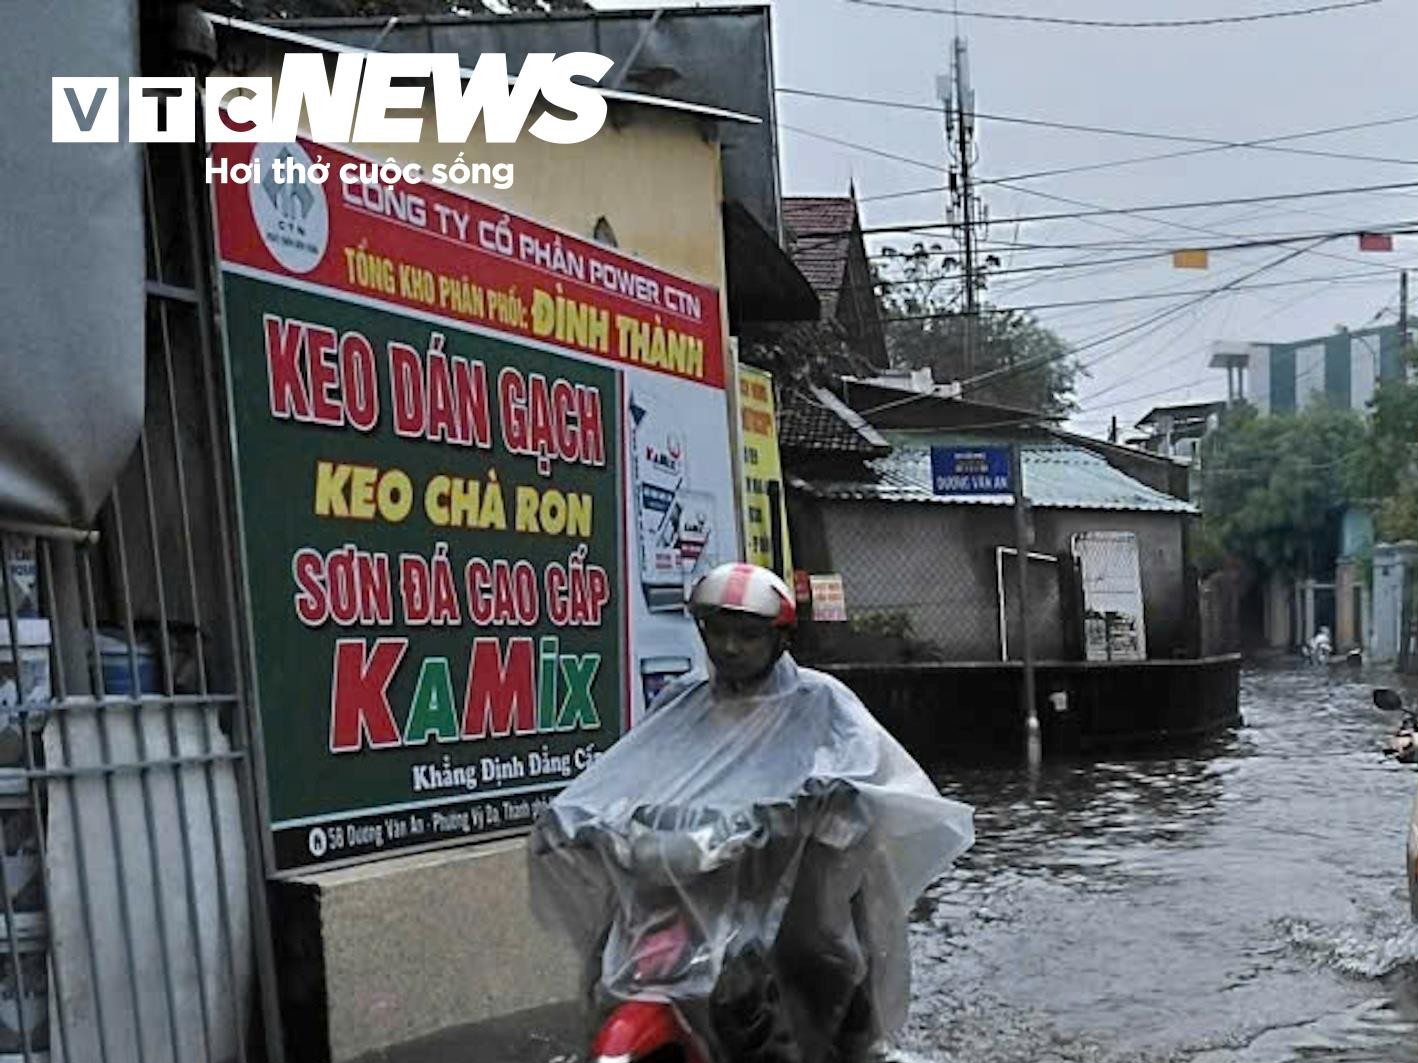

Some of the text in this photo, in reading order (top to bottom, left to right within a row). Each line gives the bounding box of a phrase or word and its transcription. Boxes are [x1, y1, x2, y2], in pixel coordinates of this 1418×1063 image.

[344, 238, 396, 294] TỔNG
[399, 263, 435, 305] KHO
[438, 275, 484, 319] PHÂN
[531, 283, 610, 354] ĐÌNH
[616, 314, 704, 379] THÀNH
[433, 202, 470, 241] TY
[478, 214, 513, 256] CỔ
[588, 259, 661, 305] POWER
[663, 284, 701, 319] CTN
[263, 313, 606, 476] KEO DÁN GẠCH
[315, 460, 594, 538] KEO CHÀ RON
[292, 542, 610, 627] SƠN ĐÁ CAO CẤP
[412, 755, 477, 792] Khẳng
[481, 755, 525, 787] Định
